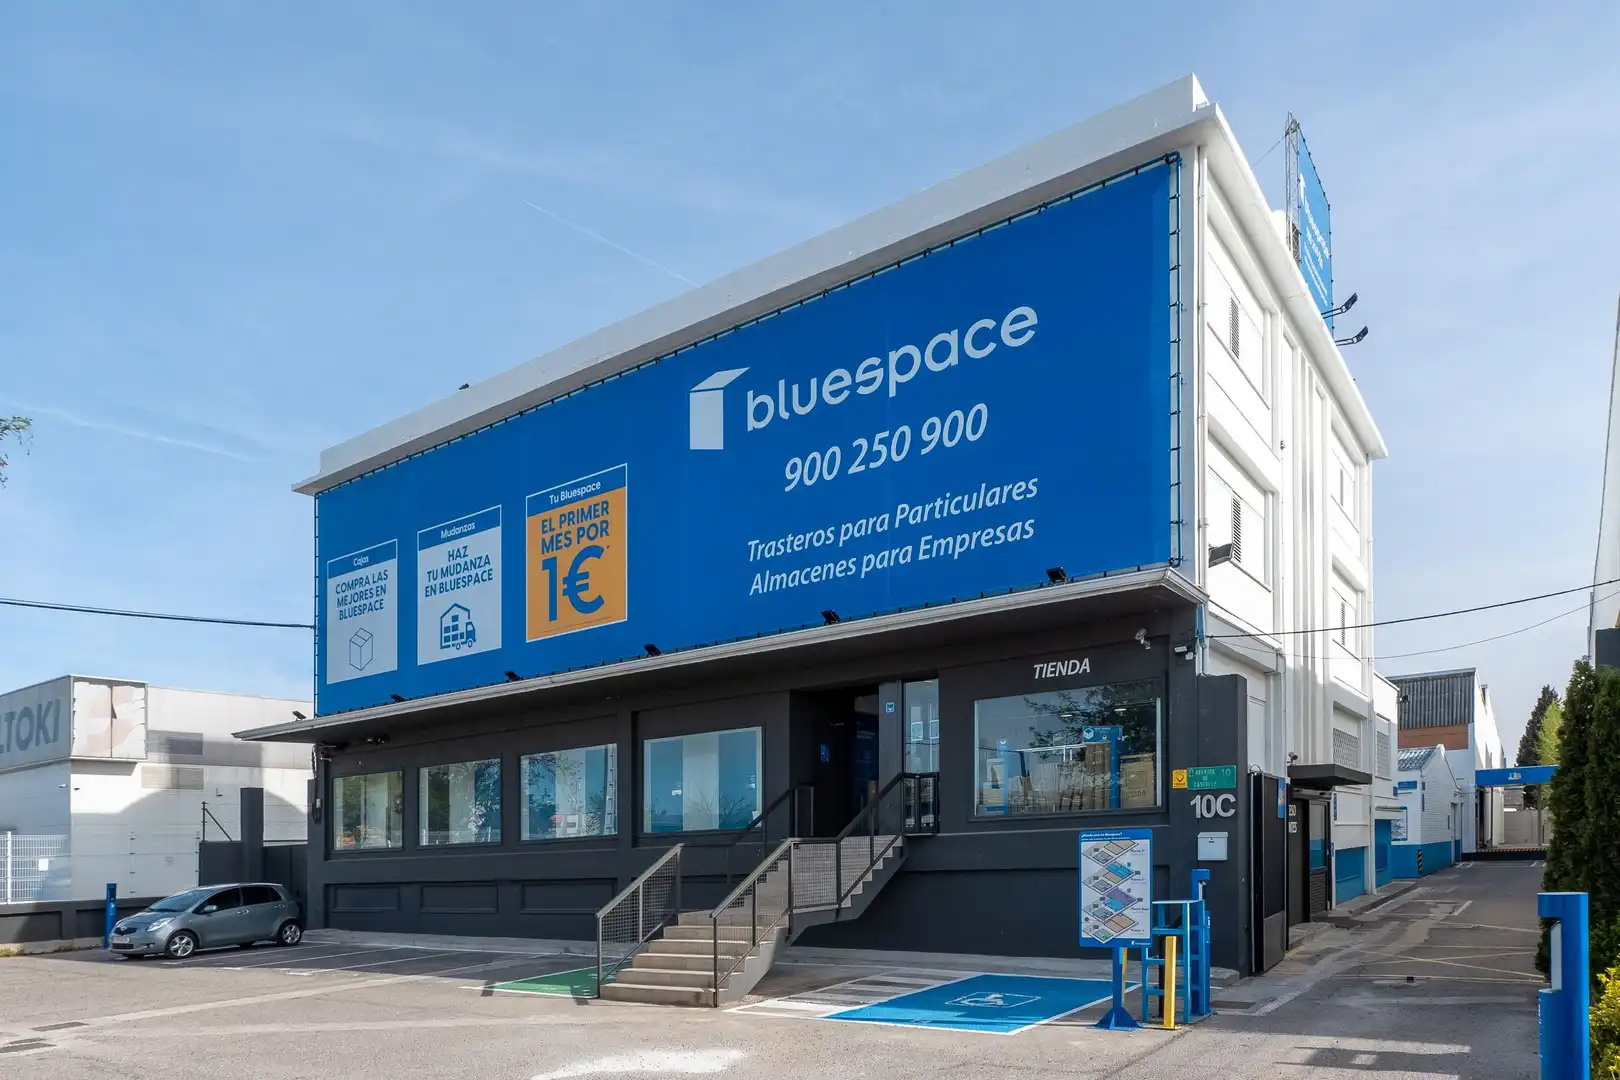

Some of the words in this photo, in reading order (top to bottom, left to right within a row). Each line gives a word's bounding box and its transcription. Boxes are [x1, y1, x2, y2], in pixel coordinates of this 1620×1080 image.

[747, 305, 1038, 432] bluespace
[785, 446, 842, 492] 900
[848, 425, 911, 475] 250
[920, 403, 989, 455] 900
[549, 493, 559, 505] Tu
[561, 480, 601, 502] Bluespace
[440, 521, 476, 539] Mudanzas
[541, 517, 555, 534] EL
[558, 500, 610, 531] PRIMER
[747, 525, 836, 562] Trasteros
[839, 513, 889, 547] para
[894, 477, 1039, 528] Particulares
[541, 533, 572, 555] MES
[576, 519, 610, 545] POR
[353, 555, 369, 567] Cajas
[447, 545, 468, 563] HAZ
[749, 557, 857, 595] Almacenes
[861, 543, 912, 578] para
[918, 518, 1036, 561] Empresas
[335, 575, 370, 596] COMPRA
[372, 569, 388, 584] LAS
[424, 584, 437, 597] EN
[439, 568, 493, 594] BLUESPACE
[427, 568, 439, 584] TU
[441, 554, 491, 579] MUDANZA
[336, 589, 373, 609] MEJORES
[375, 585, 387, 598] EN
[338, 600, 384, 621] BLUESPACE
[1033, 657, 1091, 680] TIENDA
[1190, 793, 1236, 819] 10C
